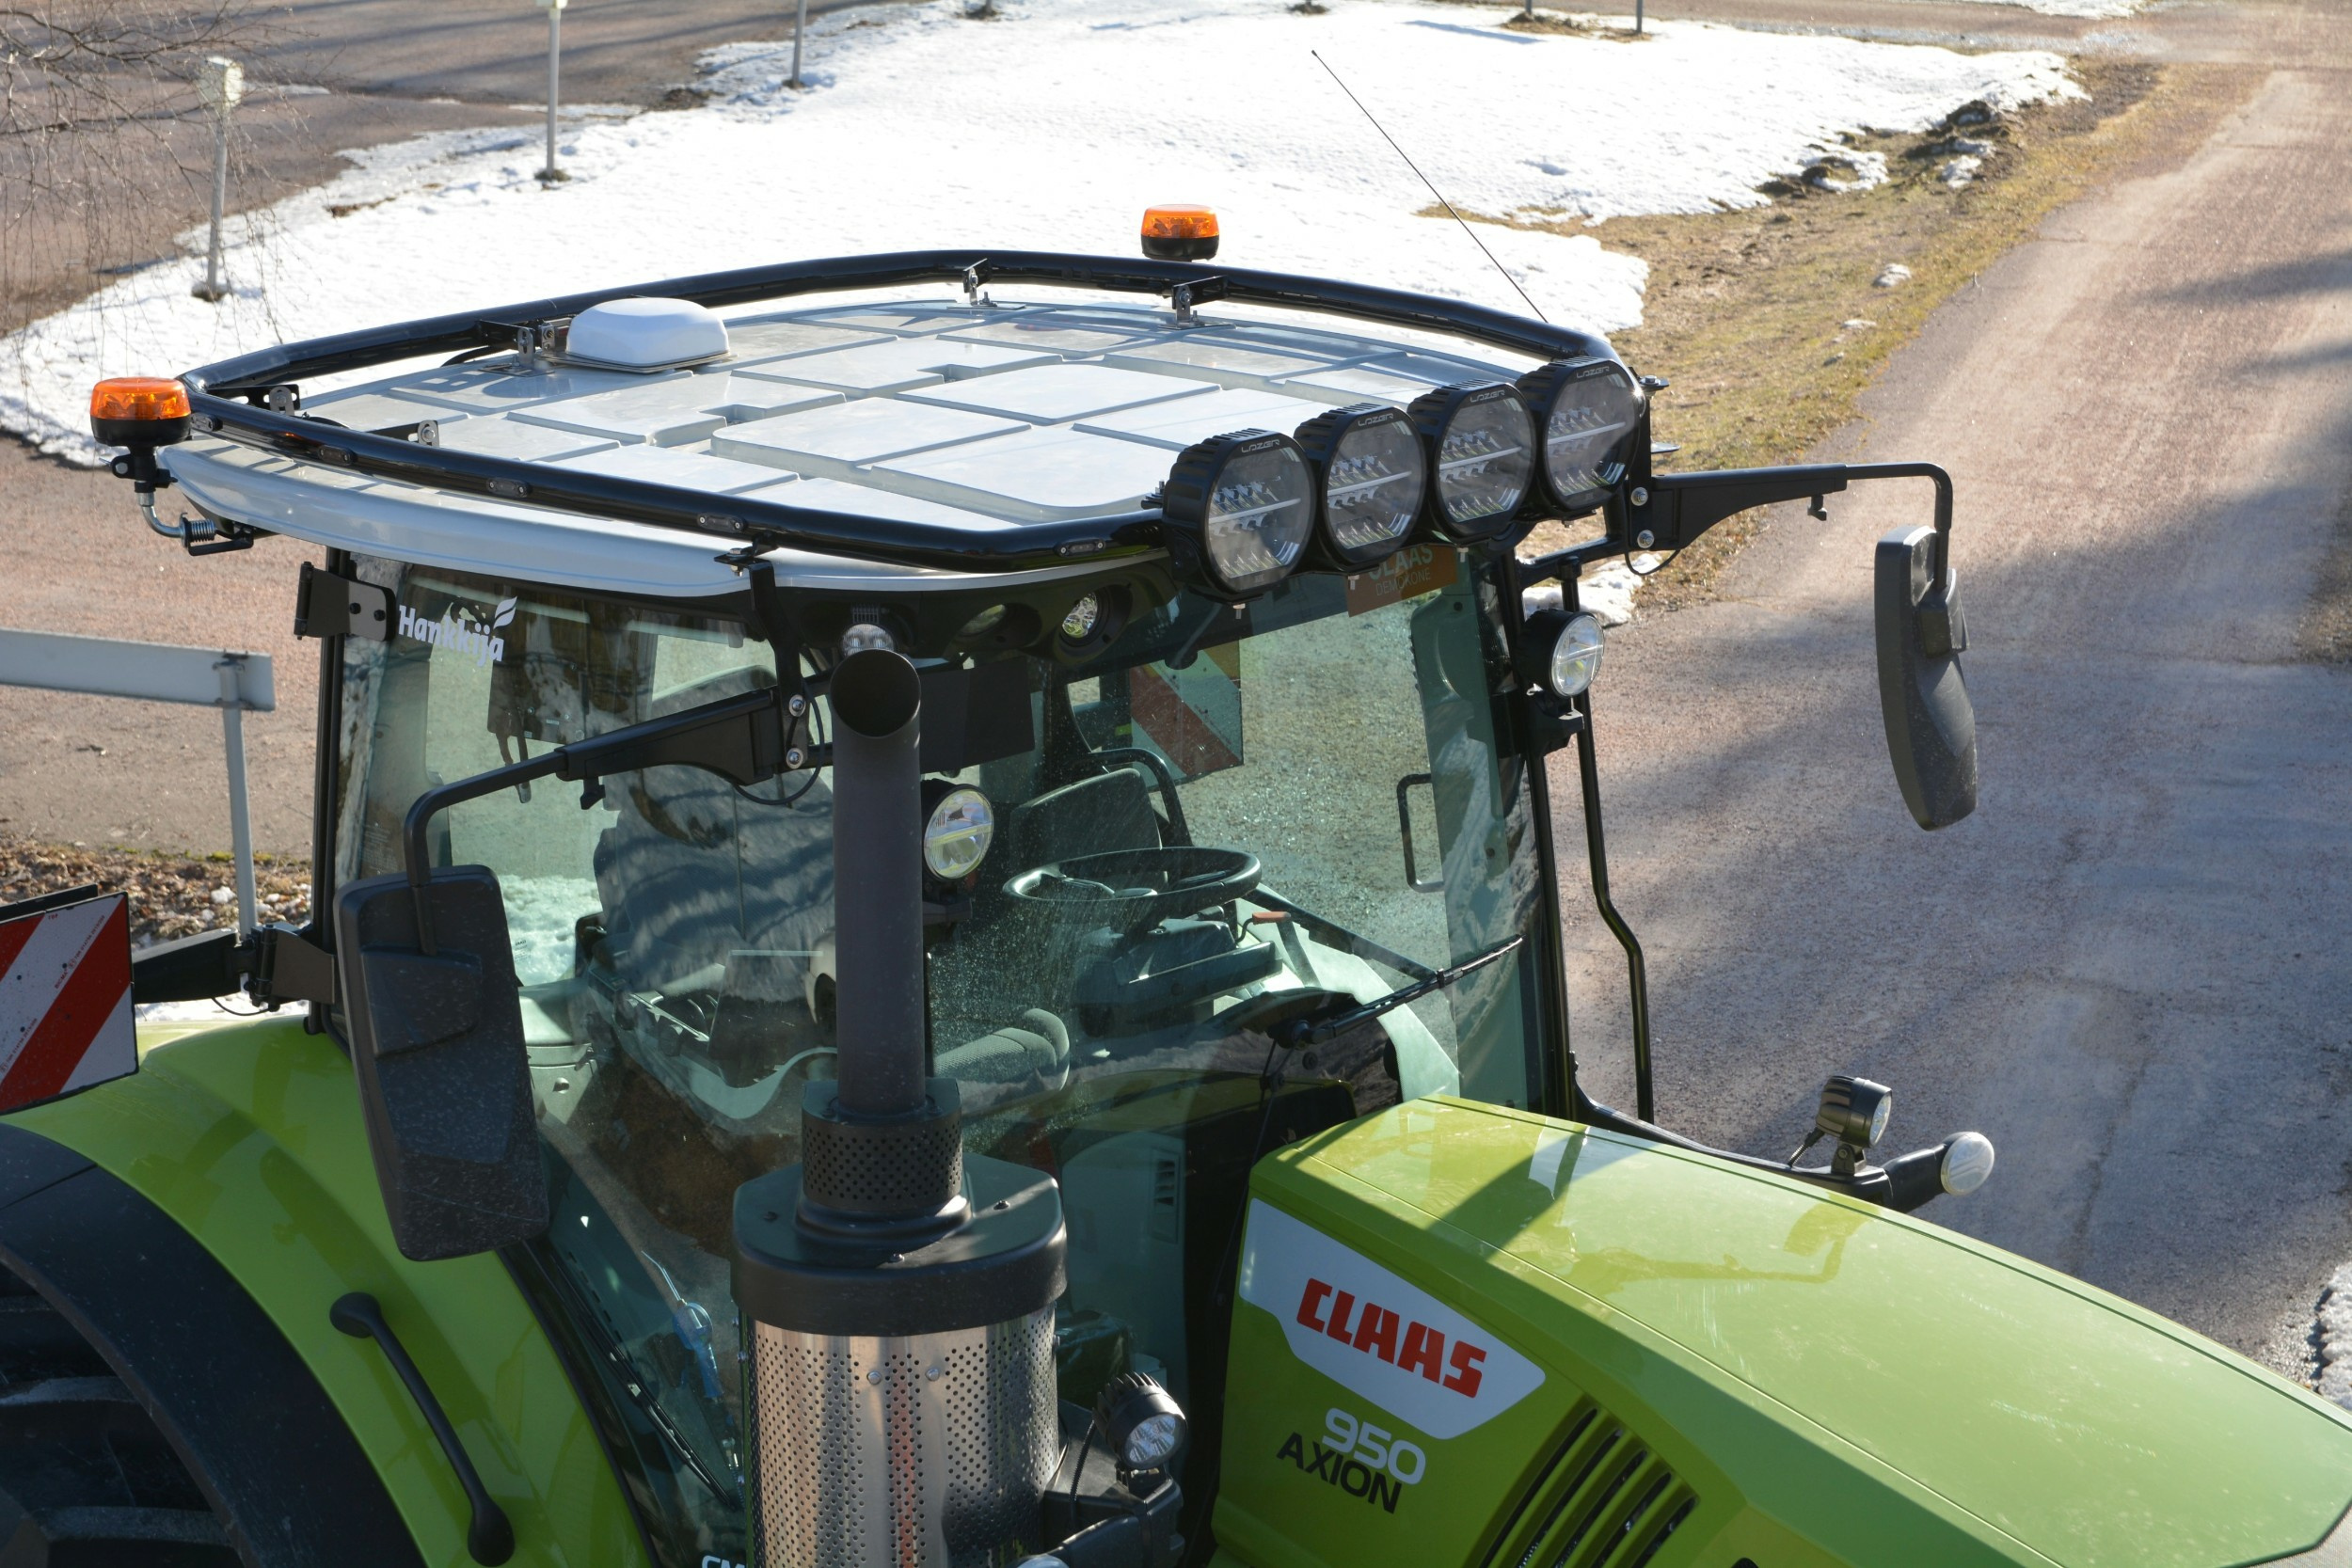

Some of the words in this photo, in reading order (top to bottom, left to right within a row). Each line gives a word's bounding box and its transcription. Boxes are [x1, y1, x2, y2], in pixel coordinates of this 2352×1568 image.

[1241, 438, 1280, 453] LAZER
[1358, 412, 1394, 427] LAZER
[1375, 567, 1431, 596] DEMOKONE
[398, 604, 504, 668] Hankkija
[1296, 1277, 1487, 1399] CLAAS
[1276, 1432, 1402, 1514] AXION
[1322, 1407, 1426, 1485] 950
